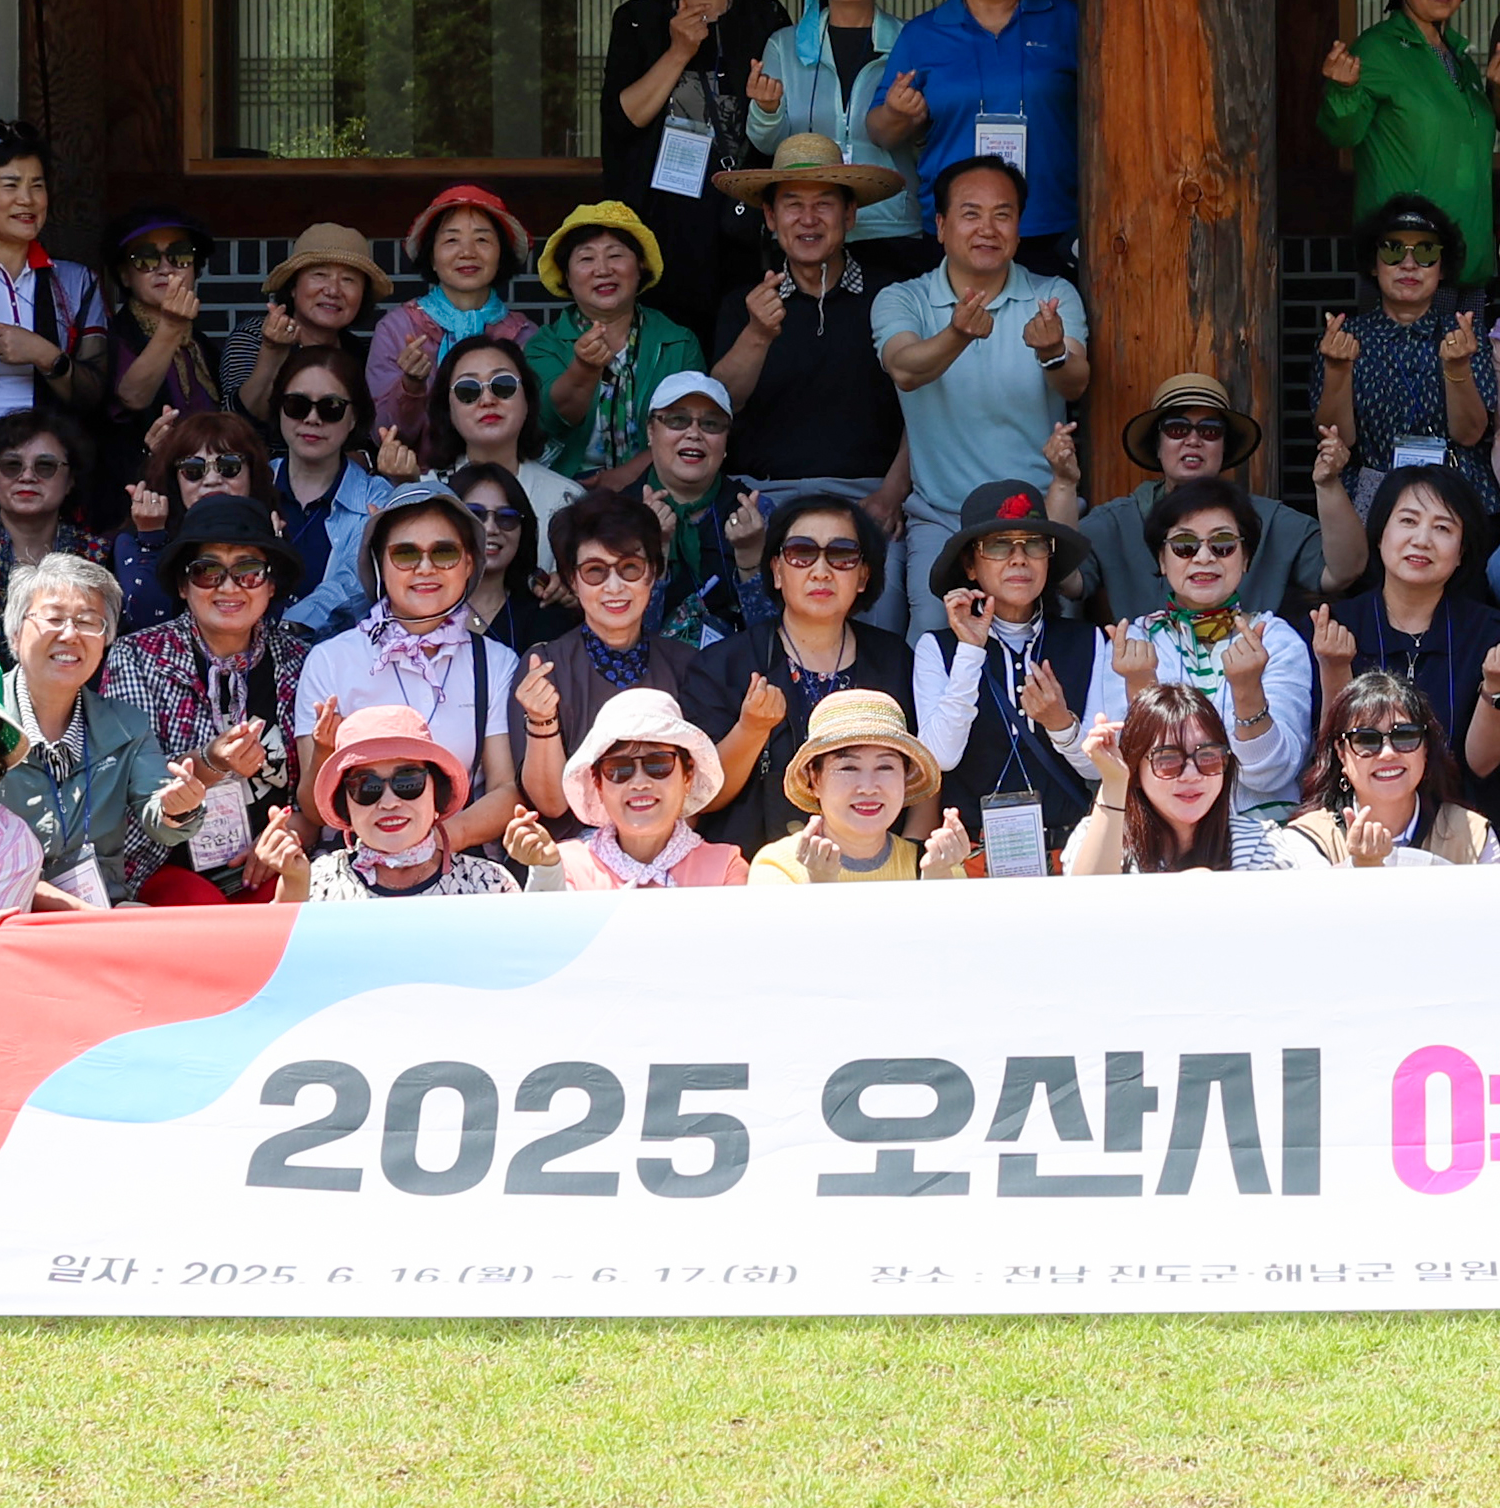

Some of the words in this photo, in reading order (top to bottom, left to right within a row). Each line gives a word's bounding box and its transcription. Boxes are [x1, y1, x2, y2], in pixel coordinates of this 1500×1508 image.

[245, 1058, 750, 1198] 2025
[816, 1047, 1323, 1198] 오산시
[47, 1254, 140, 1285] 일자
[869, 1266, 955, 1284] 장소
[1003, 1265, 1092, 1284] 전남
[1414, 1260, 1499, 1283] 일원
